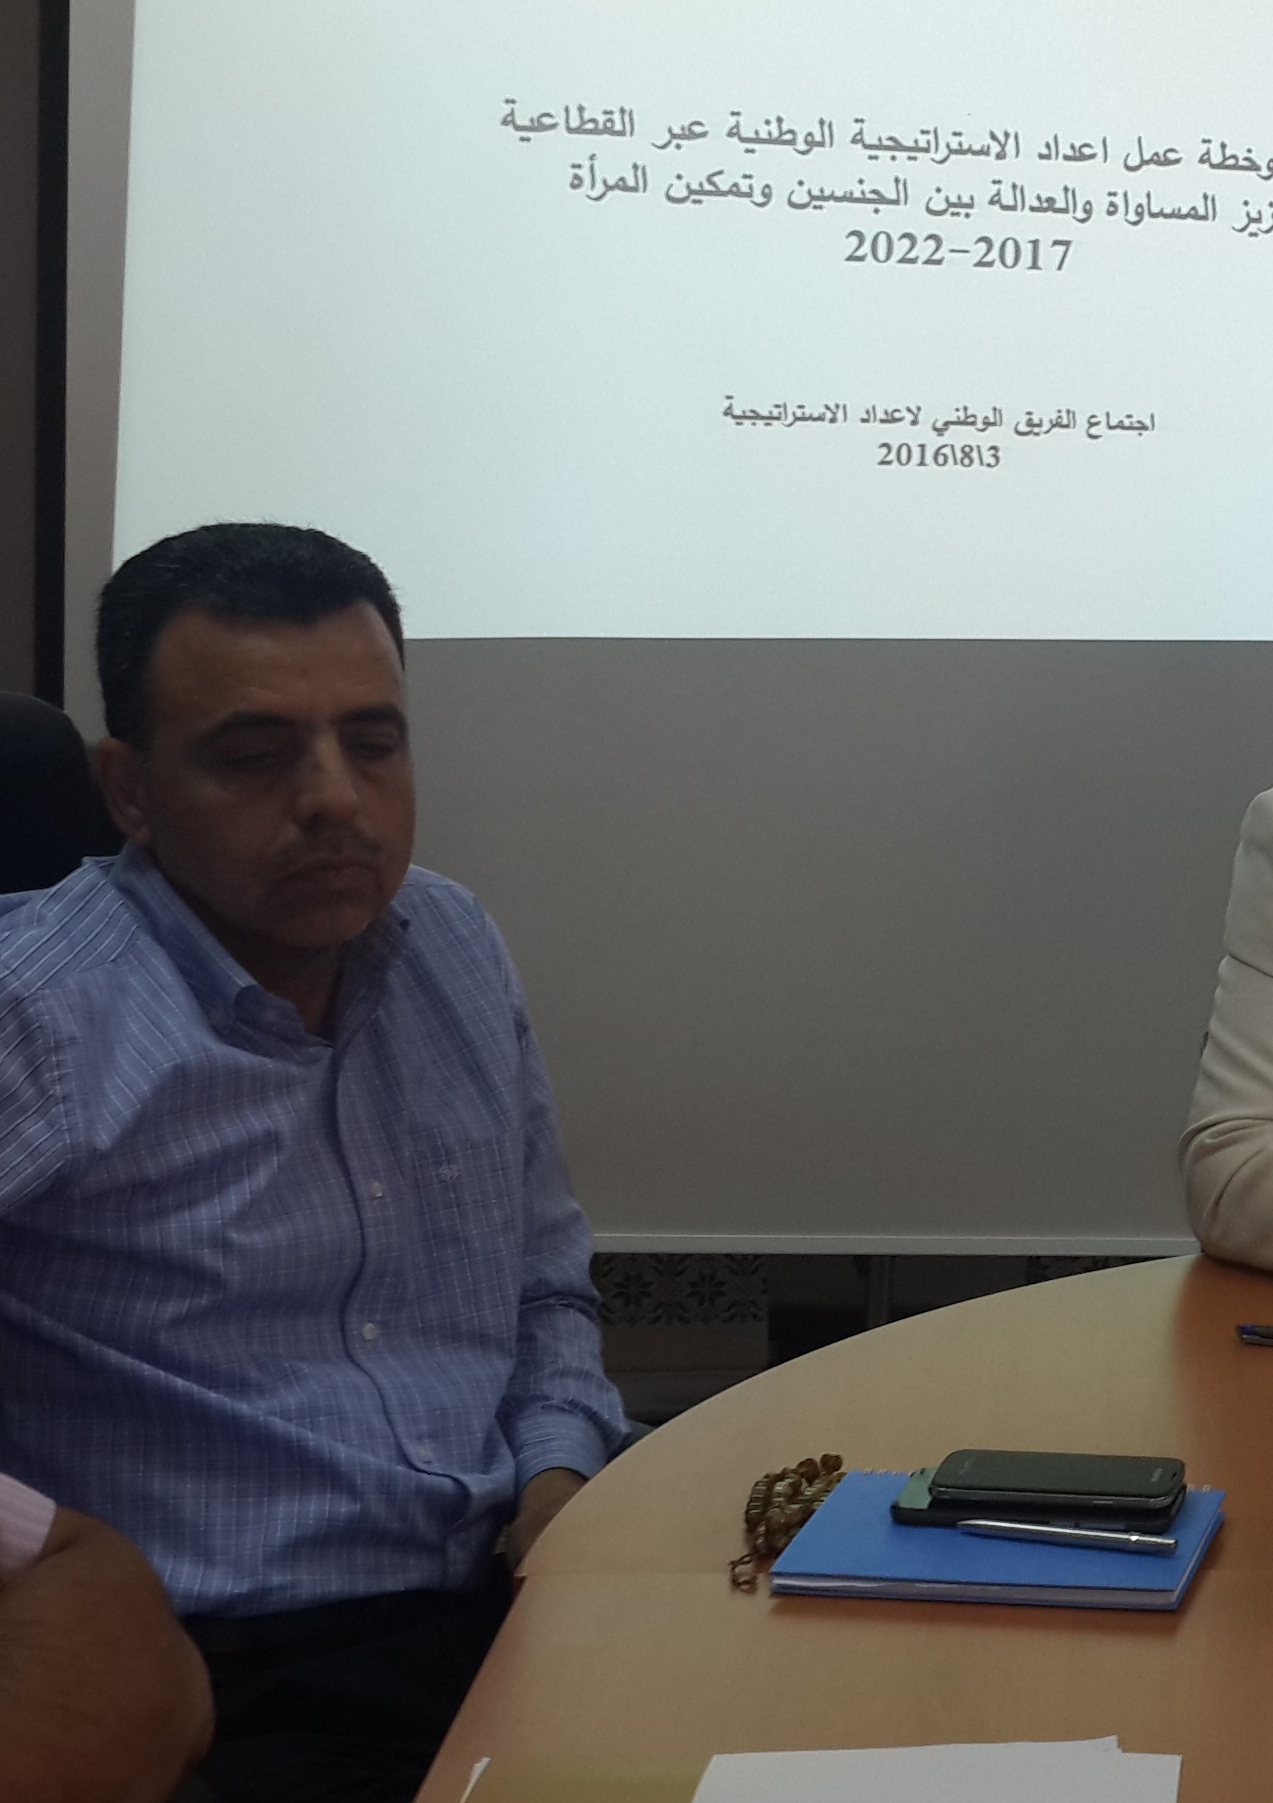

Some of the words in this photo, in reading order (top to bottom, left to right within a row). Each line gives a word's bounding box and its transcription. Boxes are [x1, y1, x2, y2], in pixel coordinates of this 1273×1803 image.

[498, 97, 635, 143] القطاعية
[650, 119, 711, 151] عبر
[725, 110, 835, 156] الوطنية
[849, 117, 1021, 165] الاستراتيجية
[1036, 132, 1109, 164] اعداد
[1123, 135, 1184, 173] عمل
[568, 153, 648, 202] المرأة
[664, 169, 773, 209] وتمكين
[786, 175, 909, 216] الجنسين
[924, 186, 975, 220] بين
[987, 178, 1094, 225] والعدالة
[1105, 190, 1218, 227] المساواة
[843, 229, 1074, 272] 2022-2017
[722, 394, 848, 428] الاستراتيجية
[859, 403, 922, 427] لاعداد
[931, 403, 1004, 435] الوطني
[1013, 408, 1077, 438] الفريق
[1085, 410, 1156, 441] اجتماع
